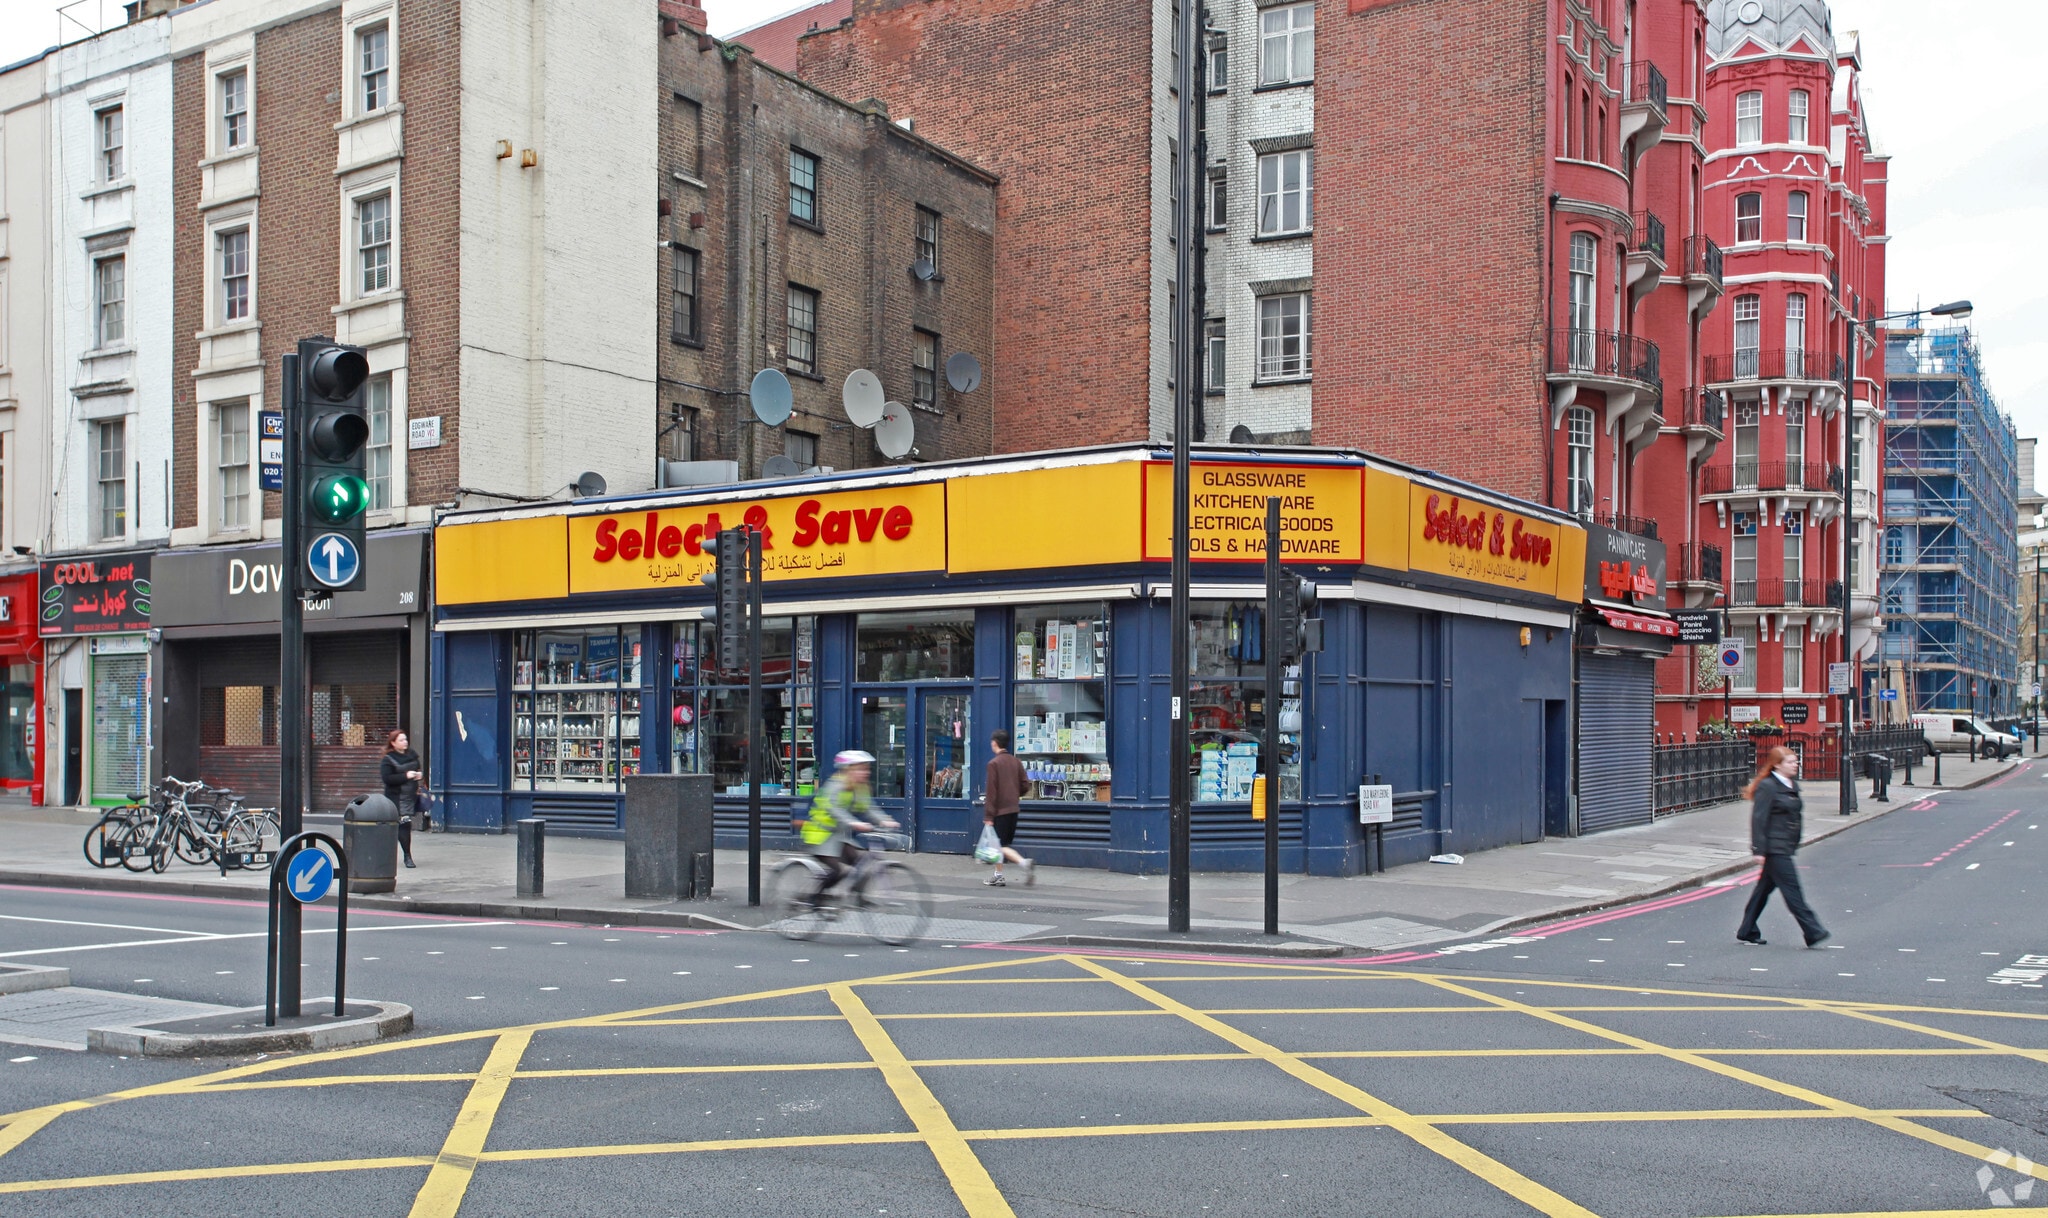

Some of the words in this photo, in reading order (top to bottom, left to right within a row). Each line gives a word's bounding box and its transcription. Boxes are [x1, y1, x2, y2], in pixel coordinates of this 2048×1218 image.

[412, 420, 434, 430] EDGWARE
[412, 430, 425, 438] ROAD
[427, 429, 435, 437] W2
[1203, 472, 1306, 488] GLASSWARE
[743, 505, 774, 550] &
[792, 499, 913, 548] Save
[1279, 517, 1333, 531] GOODS
[1424, 494, 1486, 551] Select
[1489, 512, 1505, 556] &
[1510, 518, 1552, 567] Save
[1227, 538, 1239, 552] &
[1245, 538, 1340, 554] HADWARE
[1607, 534, 1630, 556] PANINI
[1630, 540, 1646, 560] CAFE
[54, 562, 100, 585] COOL
[106, 562, 135, 581] .net
[399, 592, 414, 604] 208
